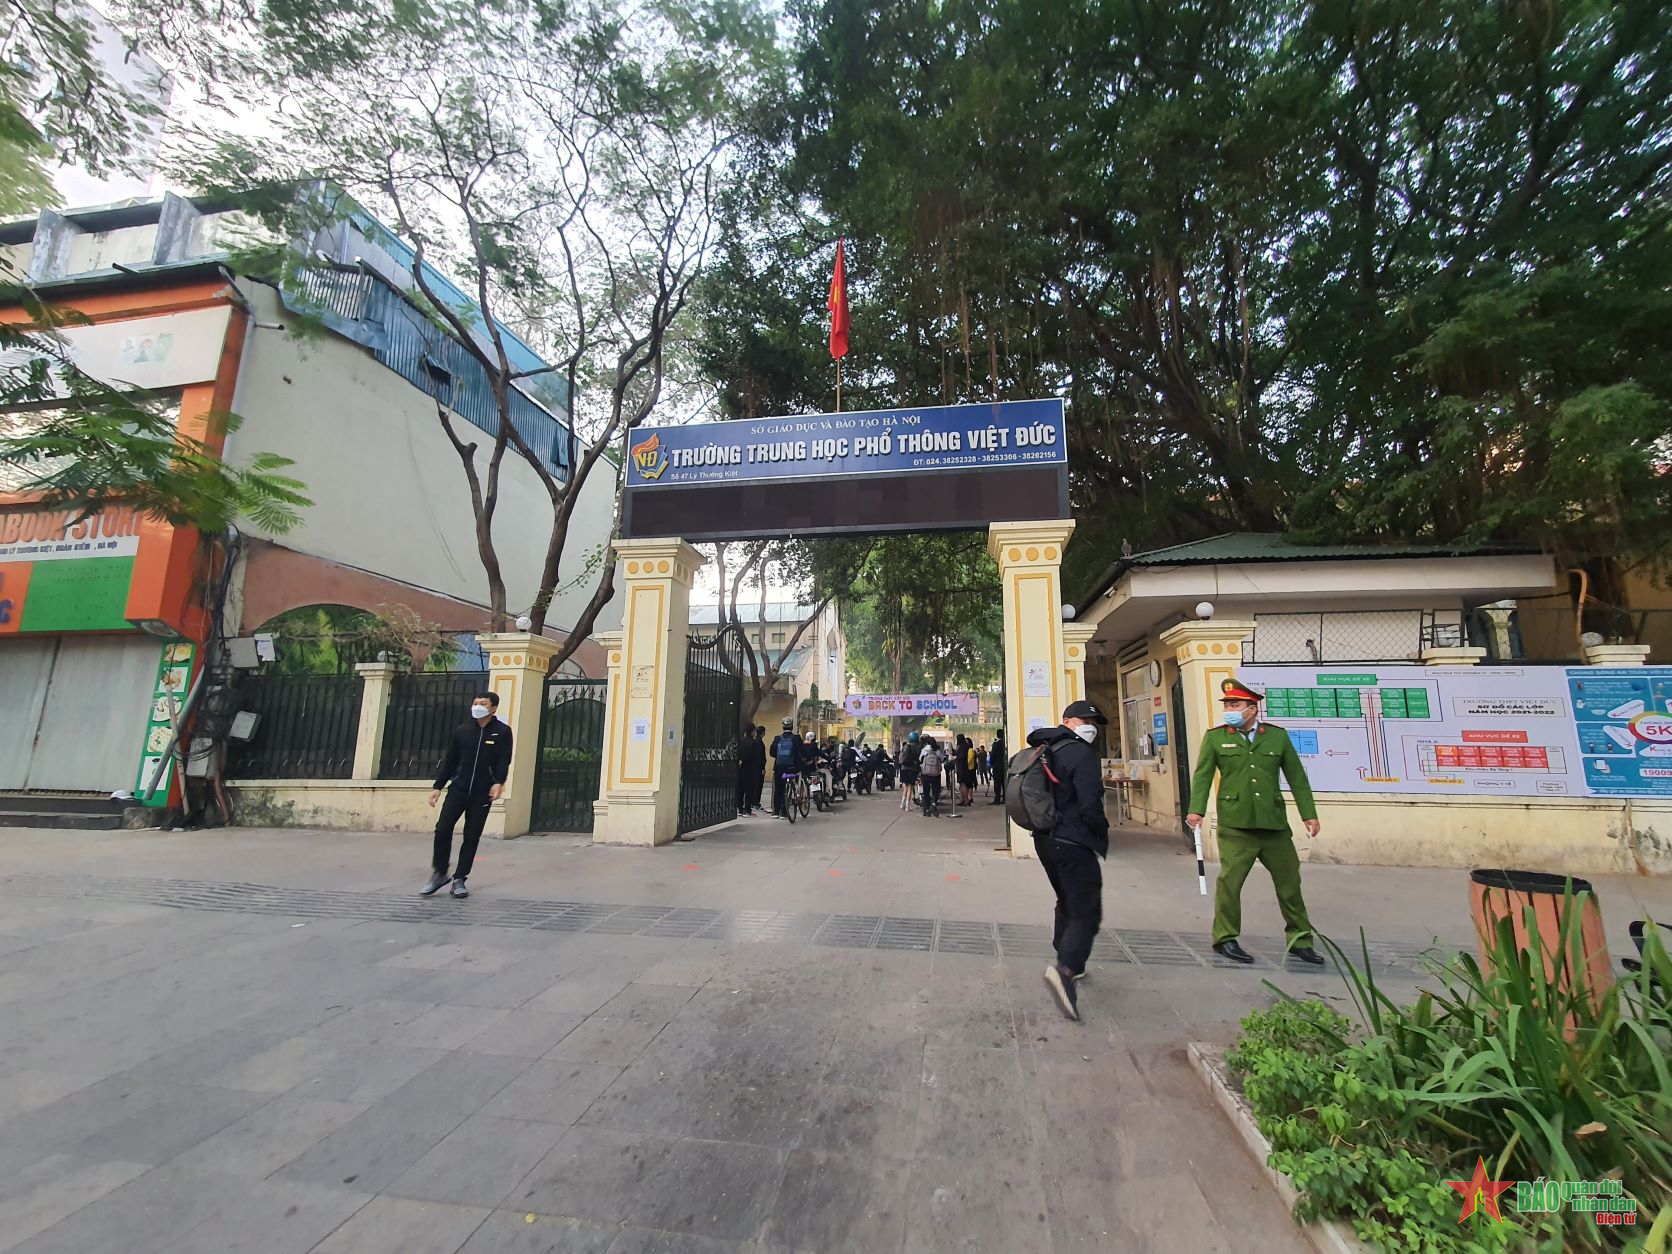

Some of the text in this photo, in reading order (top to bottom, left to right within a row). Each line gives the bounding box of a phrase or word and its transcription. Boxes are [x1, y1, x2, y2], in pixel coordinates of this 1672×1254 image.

[751, 414, 920, 435] SỞ GIÁO DỤC VÀ ĐÀO TẠO HÀ NỘI
[671, 420, 1056, 468] TRƯỜNG TRUNG HỌC PHỔ THÔNG VIỆT ĐỨC
[690, 472, 698, 480] Lý
[699, 470, 724, 479] Thường
[724, 470, 738, 478] Kiệt
[899, 700, 912, 710] TO
[916, 700, 958, 710] SCHOOL
[1646, 726, 1672, 735] 5K
